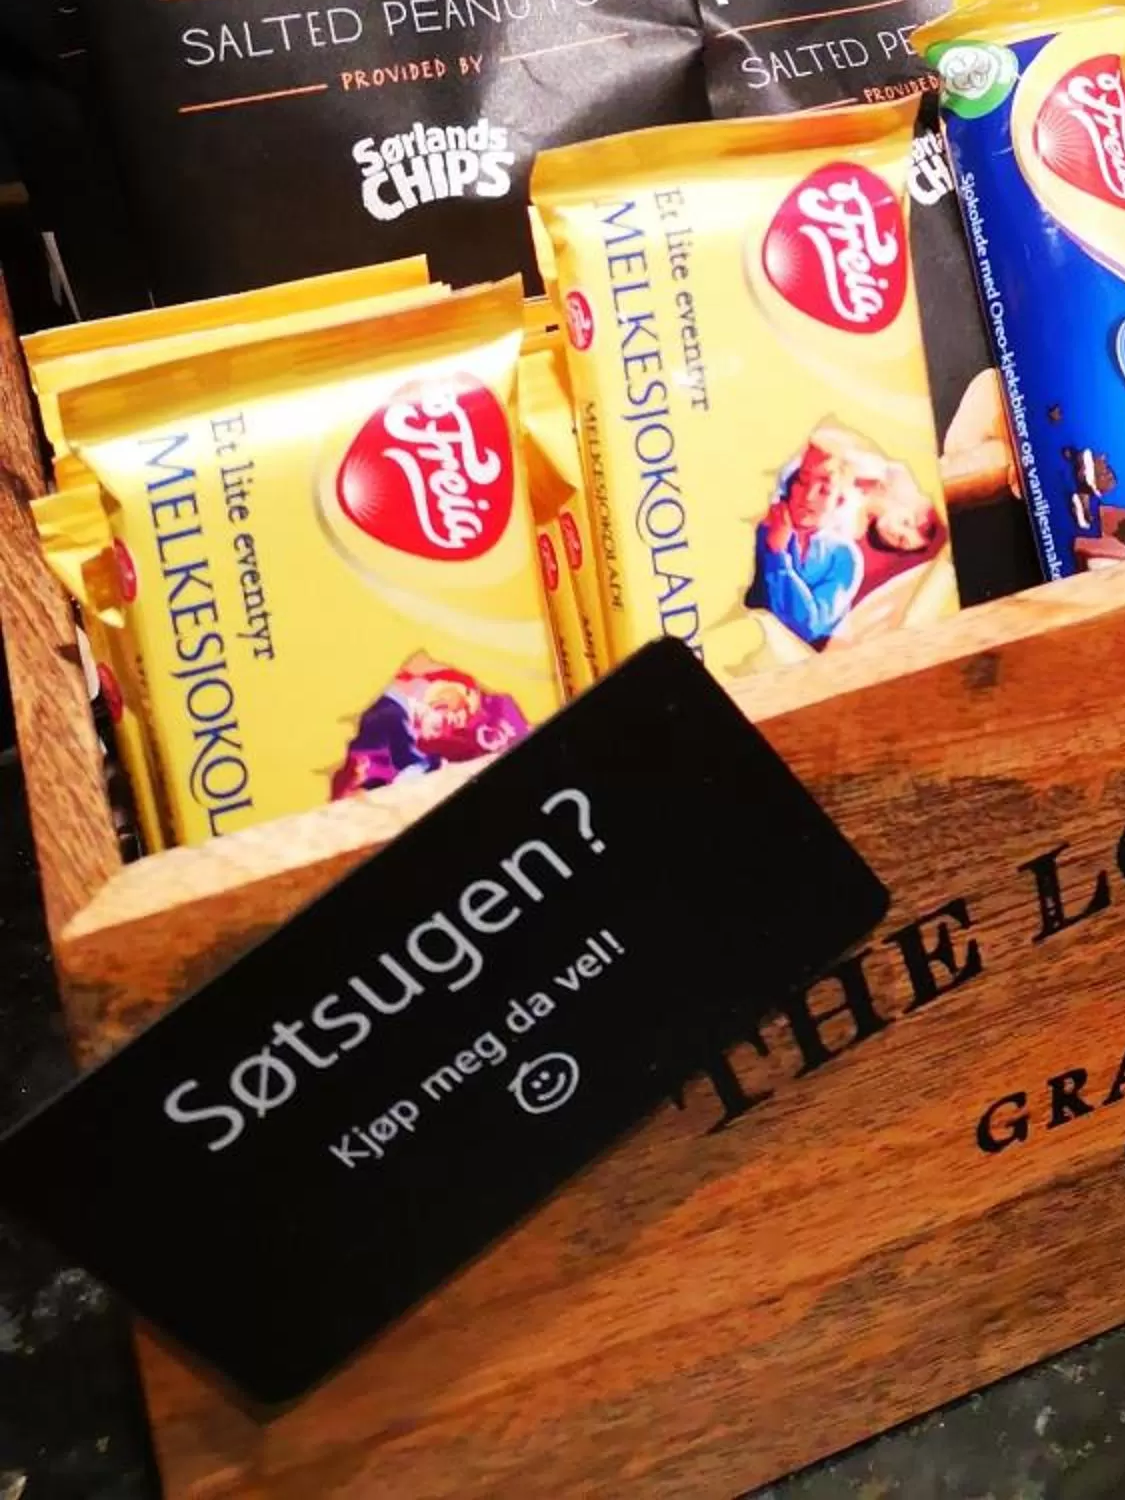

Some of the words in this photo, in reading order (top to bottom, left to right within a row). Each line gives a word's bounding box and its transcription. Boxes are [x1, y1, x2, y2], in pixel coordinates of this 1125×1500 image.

[182, 7, 363, 65] SALTED
[741, 37, 869, 89] SALTED
[341, 59, 447, 92] PROVIDED
[461, 54, 483, 75] BY
[864, 73, 939, 104] PROVIDED
[352, 118, 507, 178] Sørlands
[361, 151, 515, 221] CHIPS
[665, 222, 689, 282] lite
[675, 285, 710, 412] eventyr
[960, 172, 988, 261] Sjokolade
[981, 264, 999, 302] med
[990, 299, 1028, 437] Oreo-kjeksbiter
[1019, 437, 1034, 465] og
[210, 411, 248, 458] Et
[220, 462, 251, 524] lite
[232, 530, 275, 662] eventyr
[163, 786, 607, 1153] Søtsugen?
[671, 896, 984, 1134] THE
[329, 1099, 421, 1171] Kjøp
[422, 1034, 506, 1099] meg
[506, 992, 557, 1037] da
[556, 928, 626, 994] vel!
